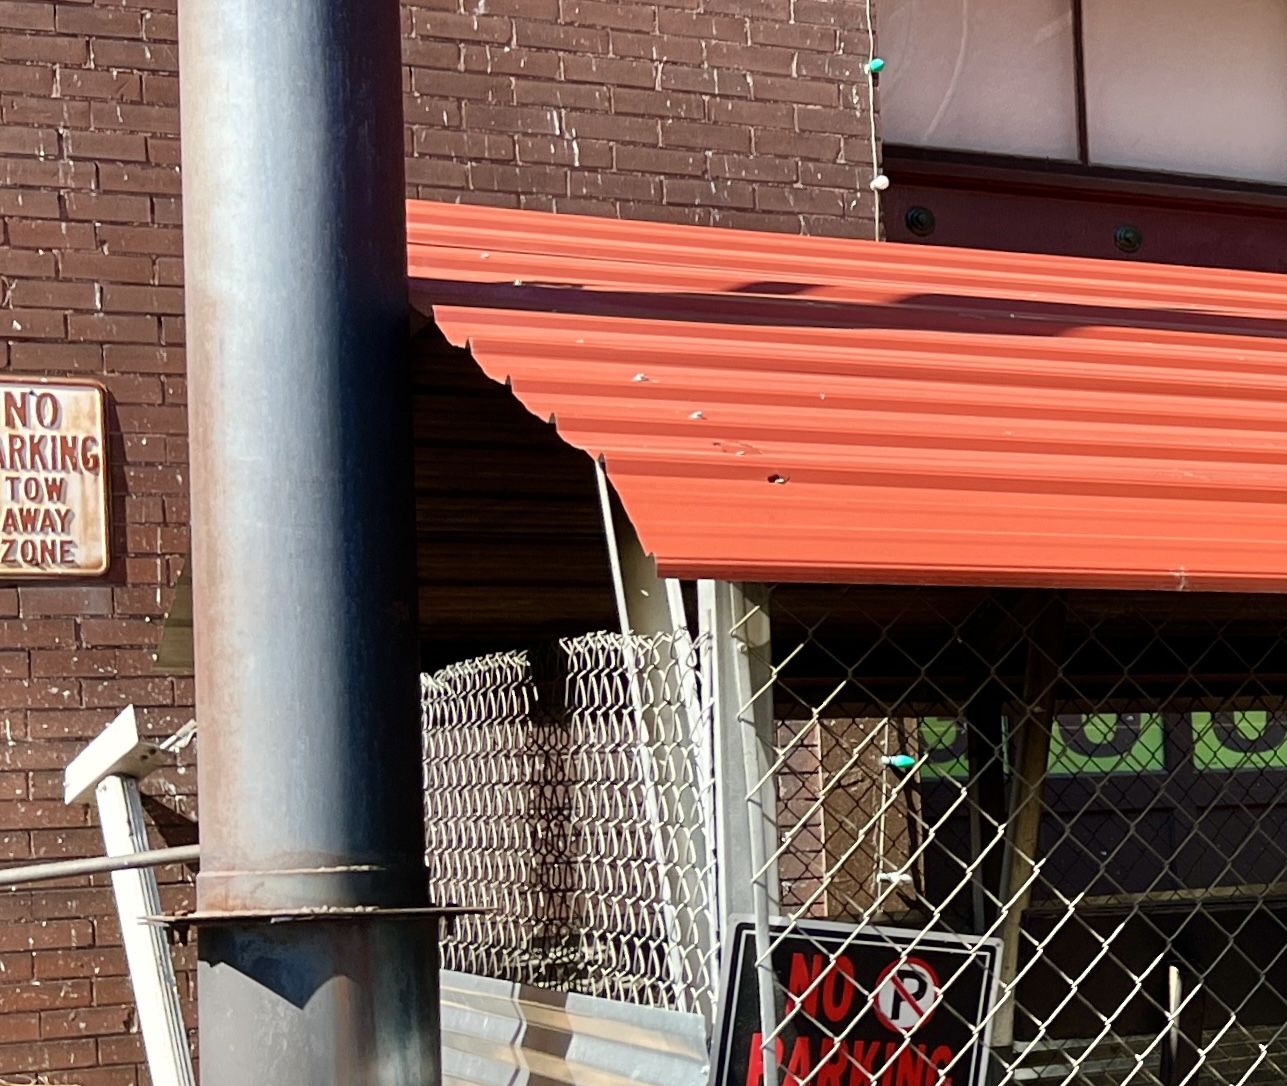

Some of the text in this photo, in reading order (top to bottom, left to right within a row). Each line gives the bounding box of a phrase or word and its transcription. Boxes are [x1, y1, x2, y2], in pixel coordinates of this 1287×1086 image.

[5, 391, 58, 429] NO
[0, 435, 99, 473] RKING
[5, 476, 65, 502] TOW
[2, 507, 72, 534] AWAY
[1, 538, 75, 565] ZONE
[785, 952, 856, 1023] NO
